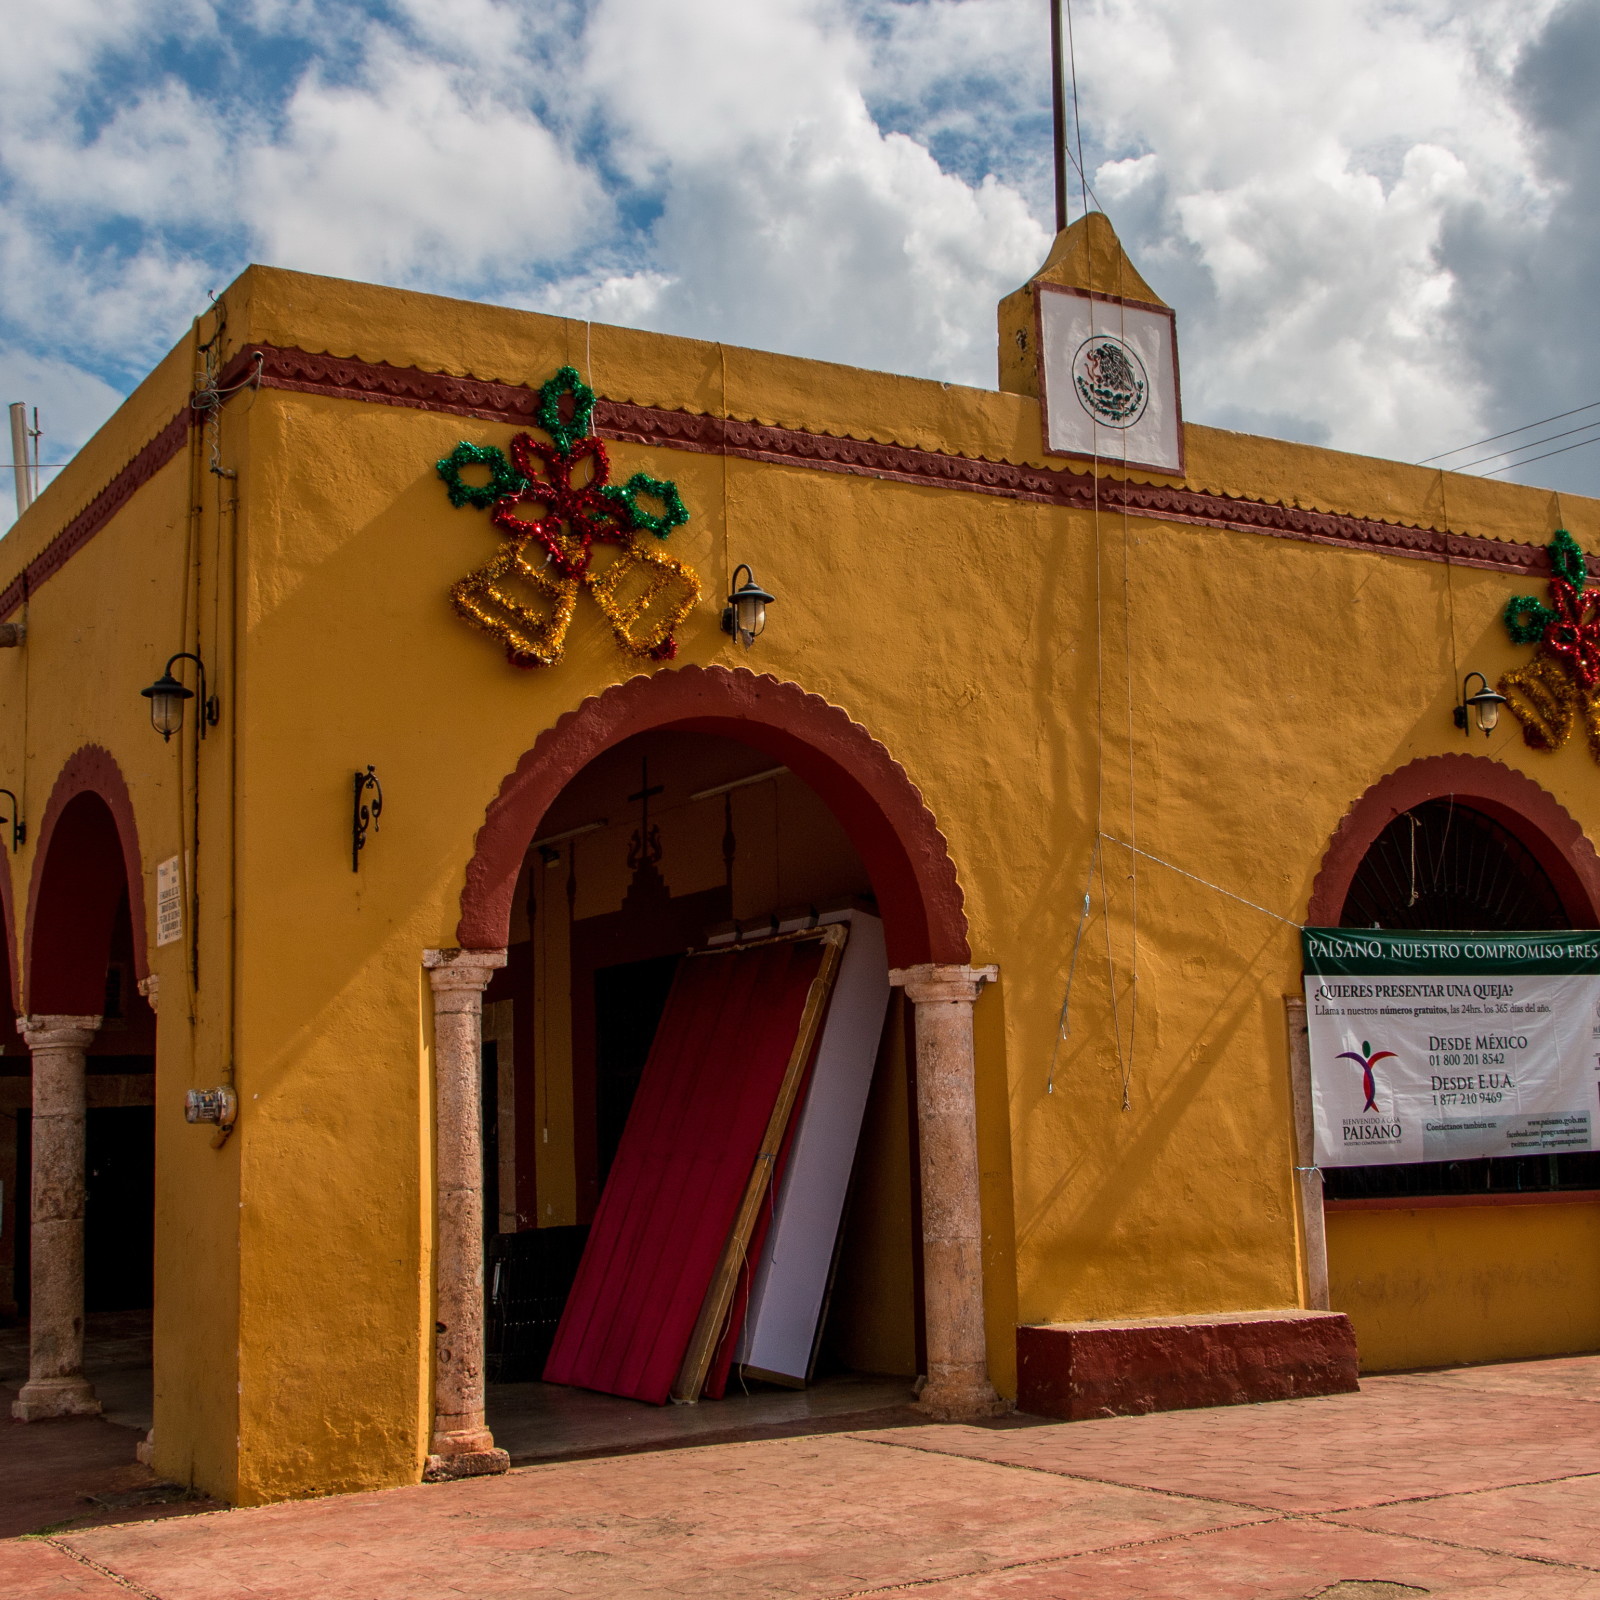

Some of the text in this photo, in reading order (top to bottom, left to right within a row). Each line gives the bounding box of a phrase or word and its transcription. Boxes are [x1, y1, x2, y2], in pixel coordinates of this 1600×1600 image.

[1308, 940, 1598, 959] PAISANO, NUESTRO COMPROMISO ERES
[1314, 984, 1514, 1001] ¿QUIERES PRESENTAR UNA QUEJA?
[1314, 1004, 1340, 1016] Llama
[1341, 1008, 1346, 1016] a
[1347, 1006, 1378, 1016] nuestros
[1379, 1004, 1412, 1016] números
[1413, 1004, 1450, 1018] gratuitos,
[1450, 1004, 1460, 1014] las
[1461, 1004, 1483, 1014] 24hrs.
[1484, 1003, 1494, 1014] los
[1495, 1003, 1508, 1014] 365
[1525, 1002, 1536, 1013] del
[1429, 1033, 1528, 1051] DESDE MÉXICO
[1429, 1052, 1505, 1066] 01 800 201 8542
[1431, 1073, 1515, 1091] DESDE E.U.A.
[1432, 1091, 1503, 1106] 1 877 210 9469
[1342, 1117, 1380, 1126] BIENVENIDO
[1342, 1123, 1402, 1141] PAISANO
